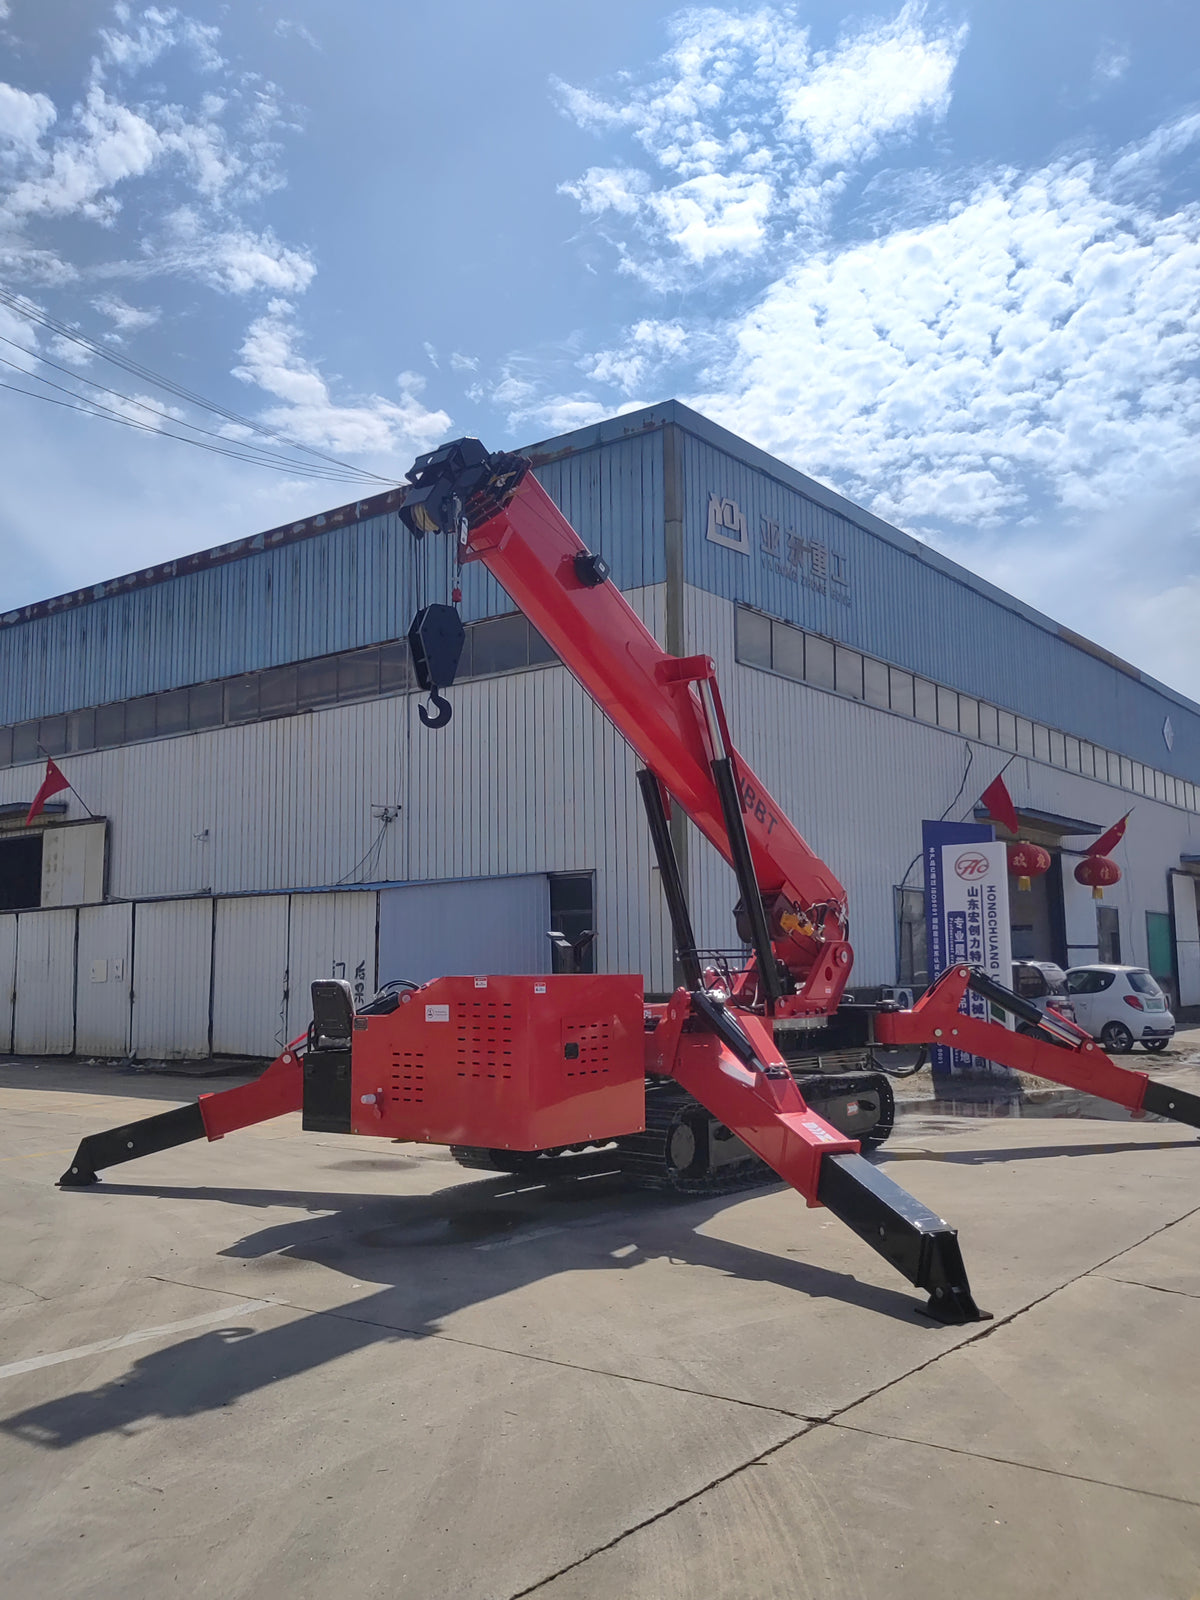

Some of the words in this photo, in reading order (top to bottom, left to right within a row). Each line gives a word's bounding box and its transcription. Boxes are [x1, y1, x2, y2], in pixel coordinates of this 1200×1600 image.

[760, 513, 848, 588] 亚东重工
[986, 885, 999, 969] HONGCHUANG
